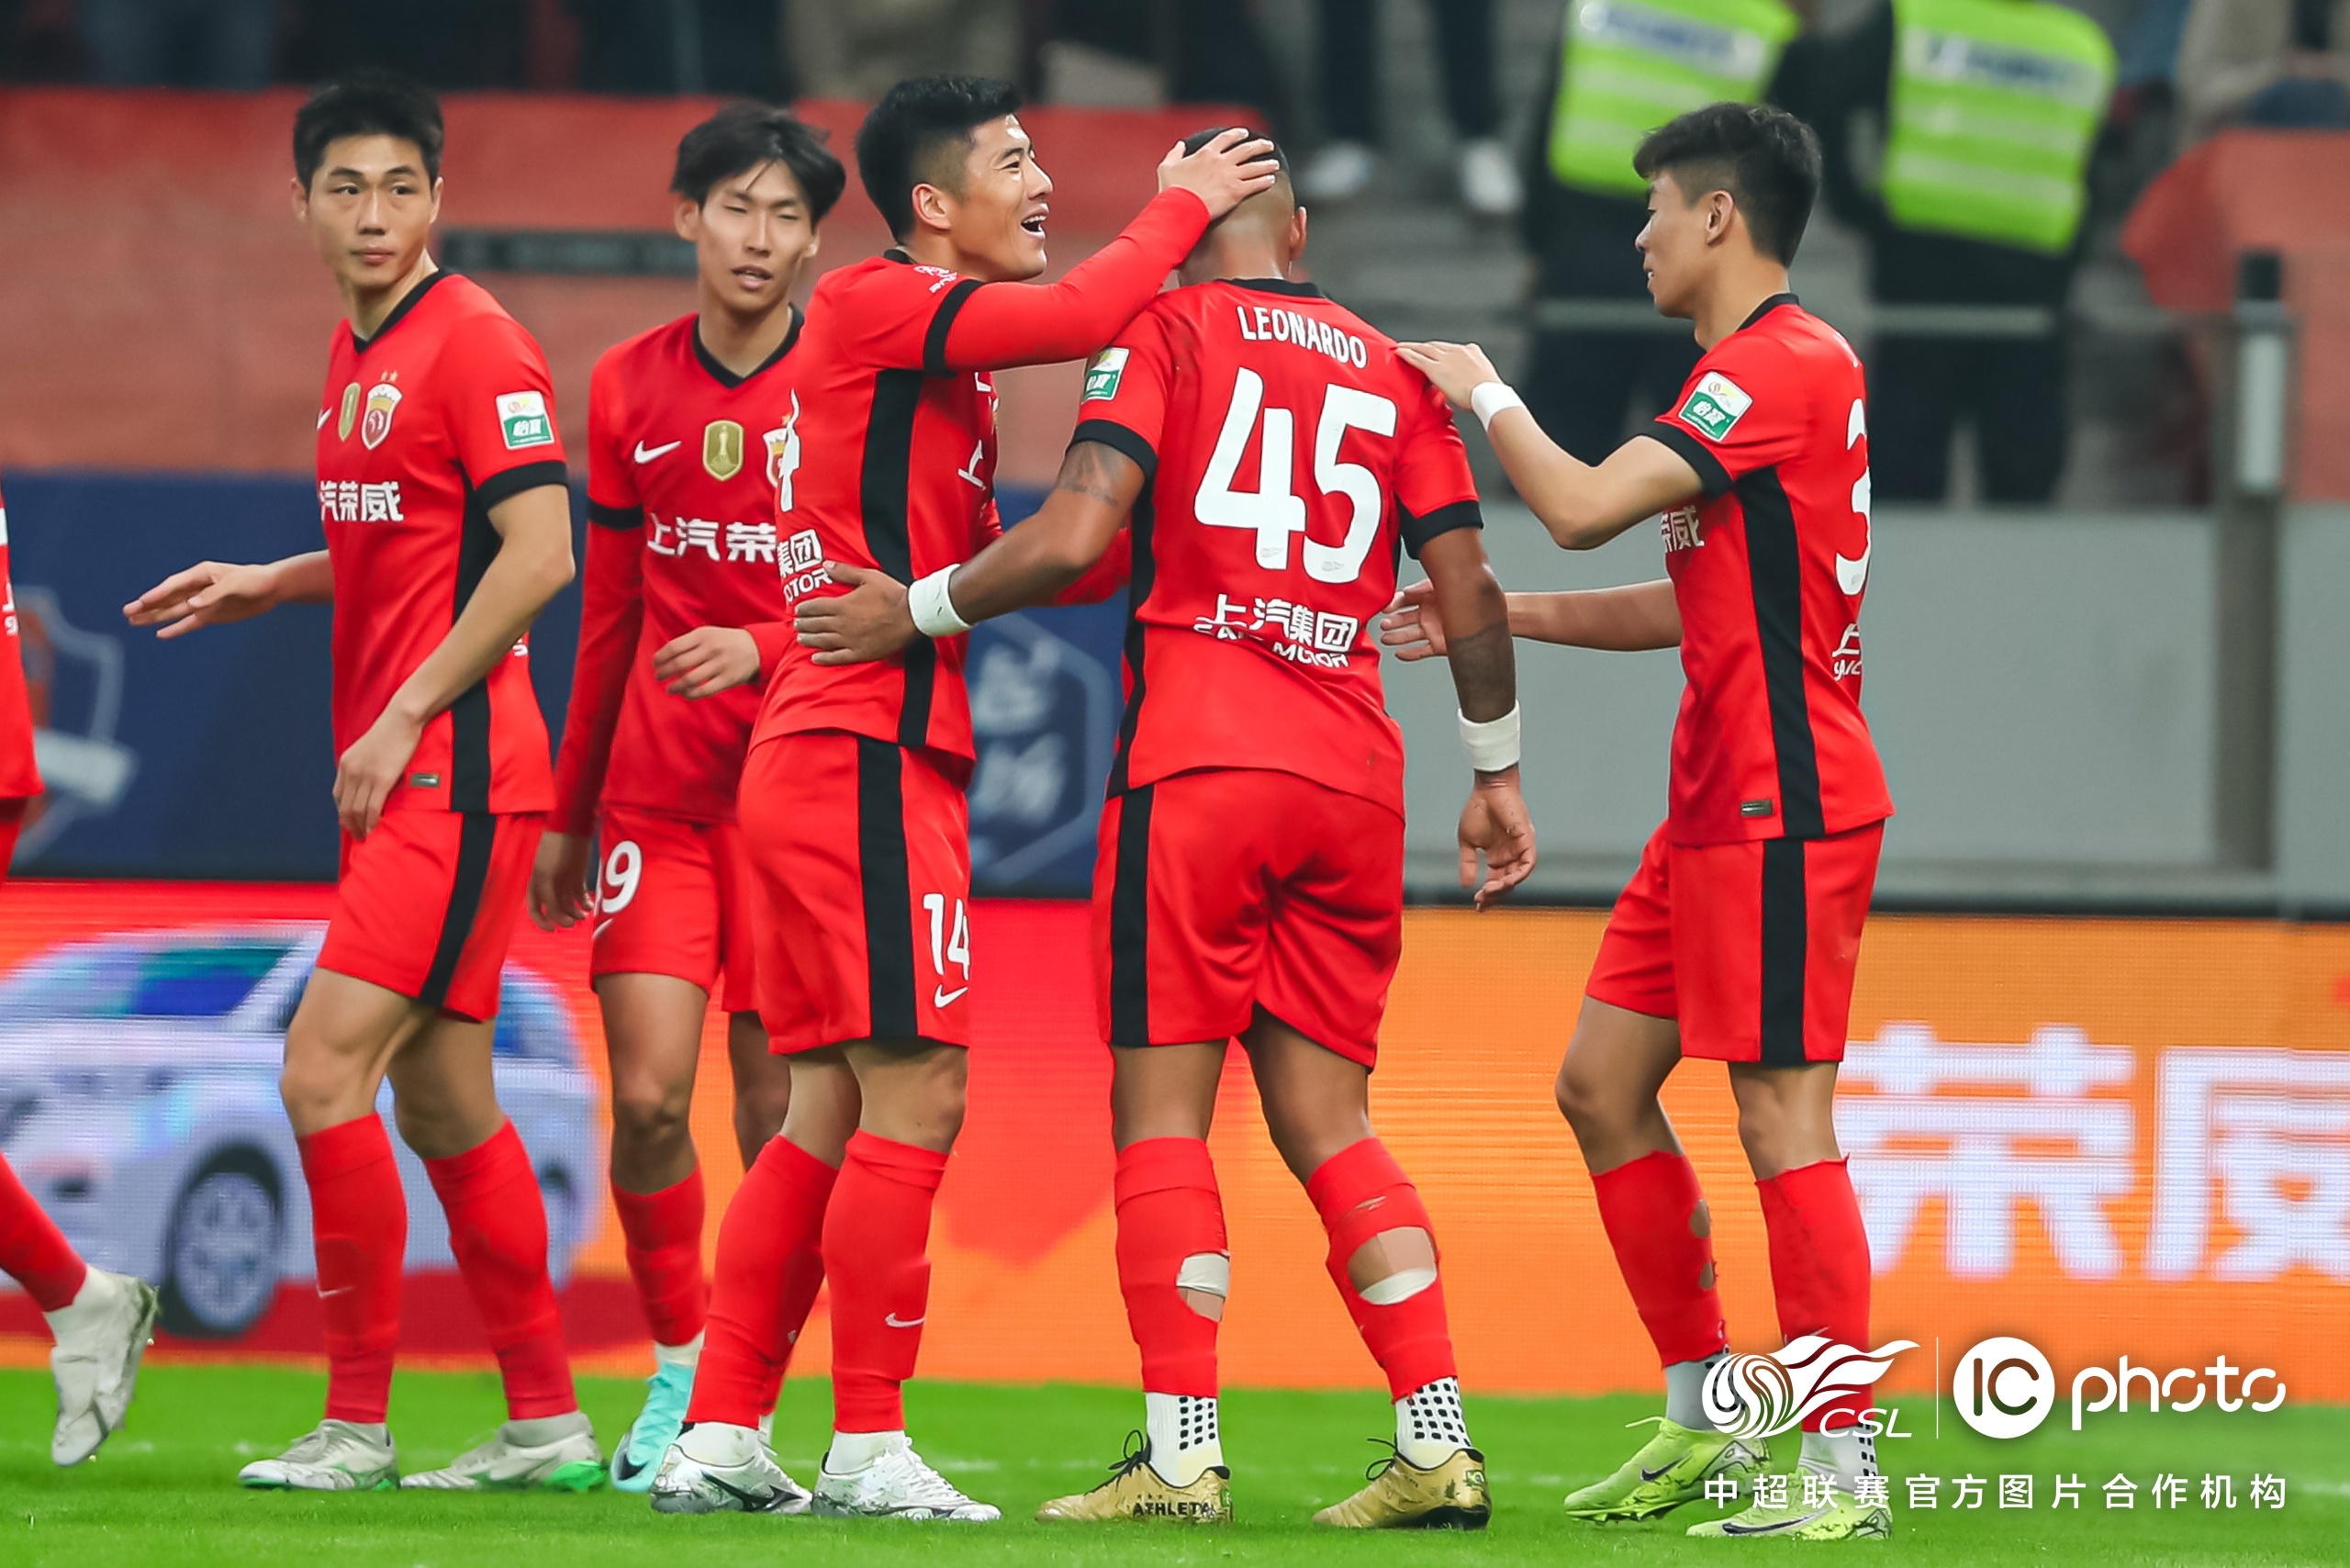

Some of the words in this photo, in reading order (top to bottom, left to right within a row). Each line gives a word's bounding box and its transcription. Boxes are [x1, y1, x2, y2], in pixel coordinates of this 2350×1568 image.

[1236, 305, 1369, 369] LEONARDO
[1193, 366, 1398, 584] 45
[1194, 593, 1359, 653] 上汽集团
[922, 892, 970, 981] 14
